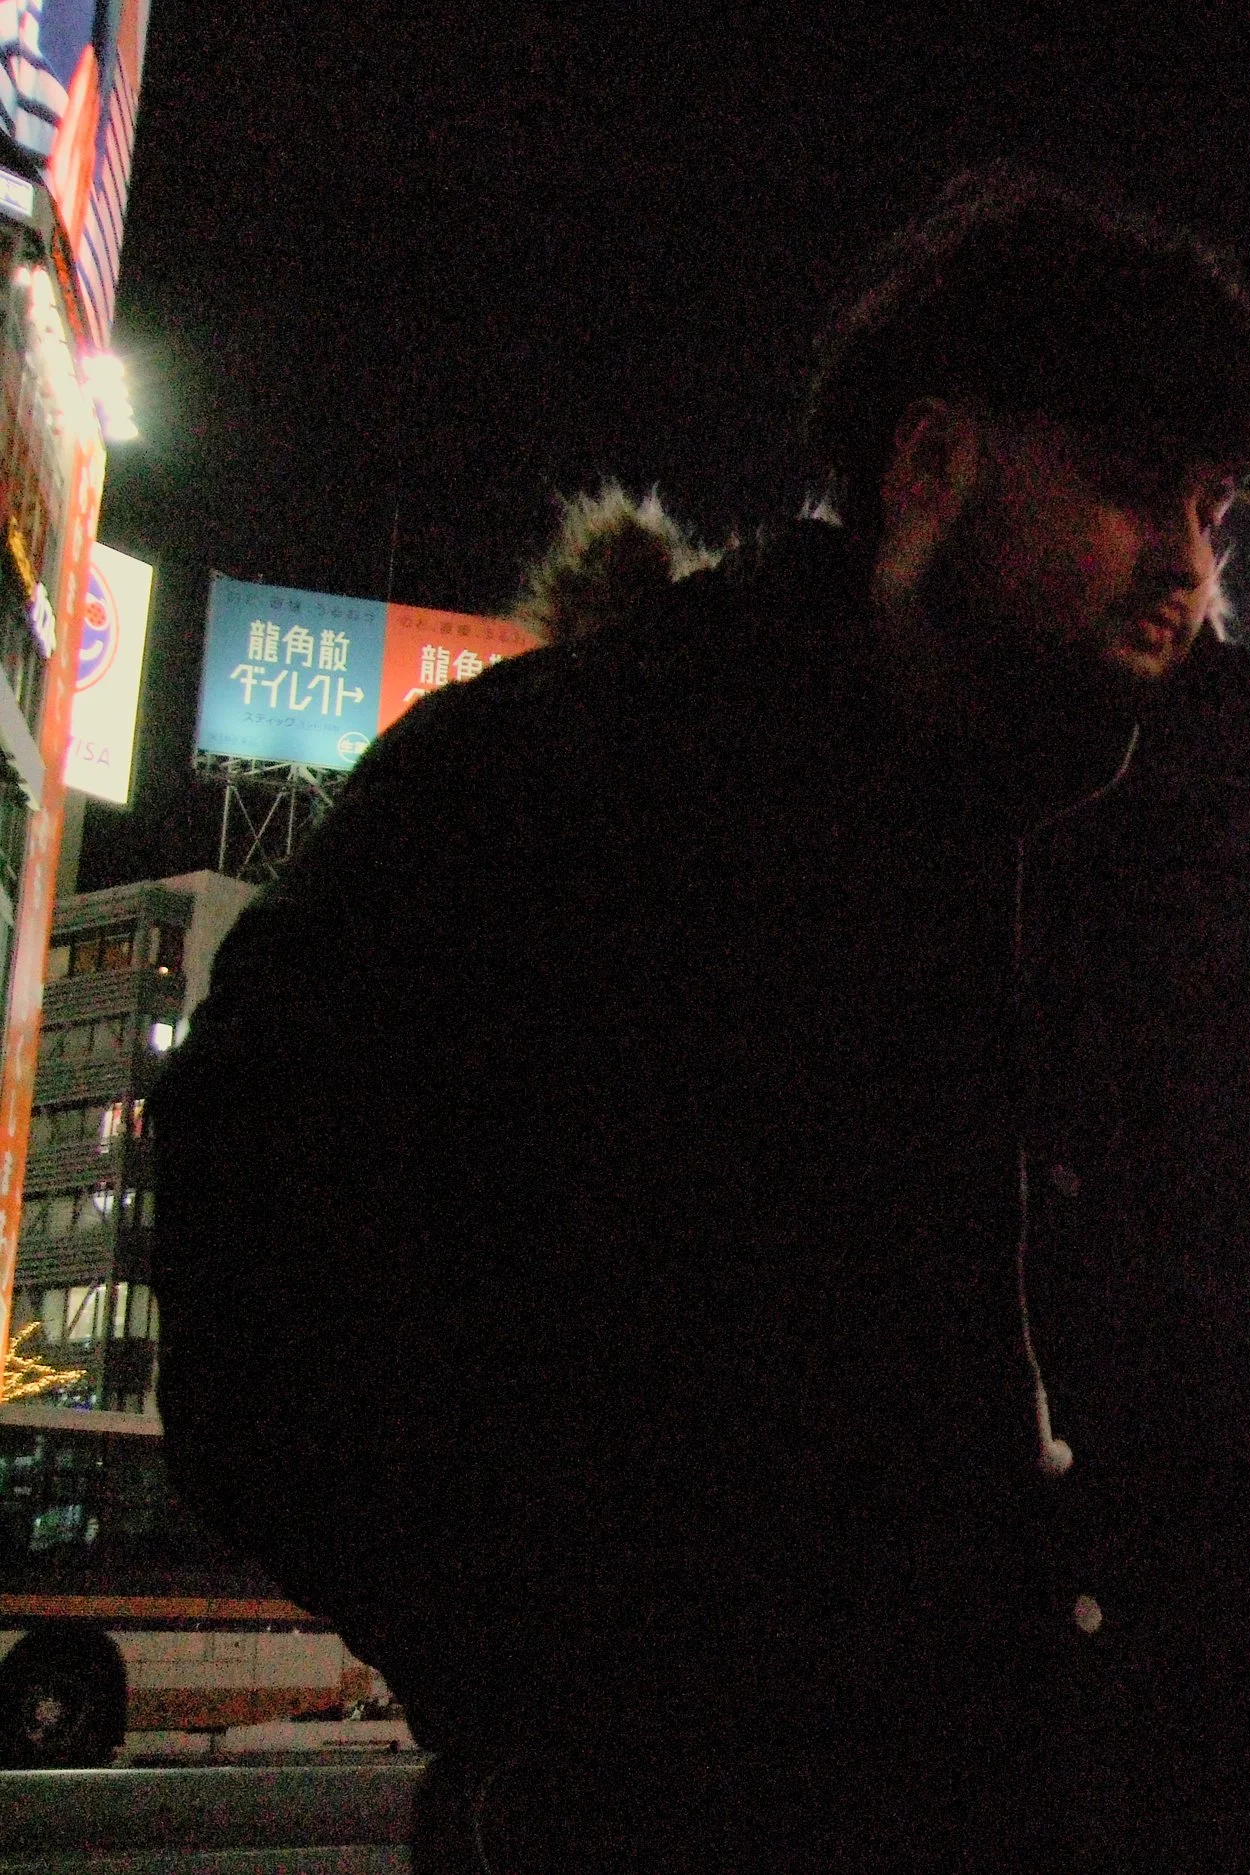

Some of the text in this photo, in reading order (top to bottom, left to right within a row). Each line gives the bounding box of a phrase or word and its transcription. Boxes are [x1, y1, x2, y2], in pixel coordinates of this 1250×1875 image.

[248, 620, 350, 672] 龍角散
[420, 645, 502, 686] 龍角
[229, 664, 364, 717] ダイレクト
[68, 735, 110, 768] ISA
